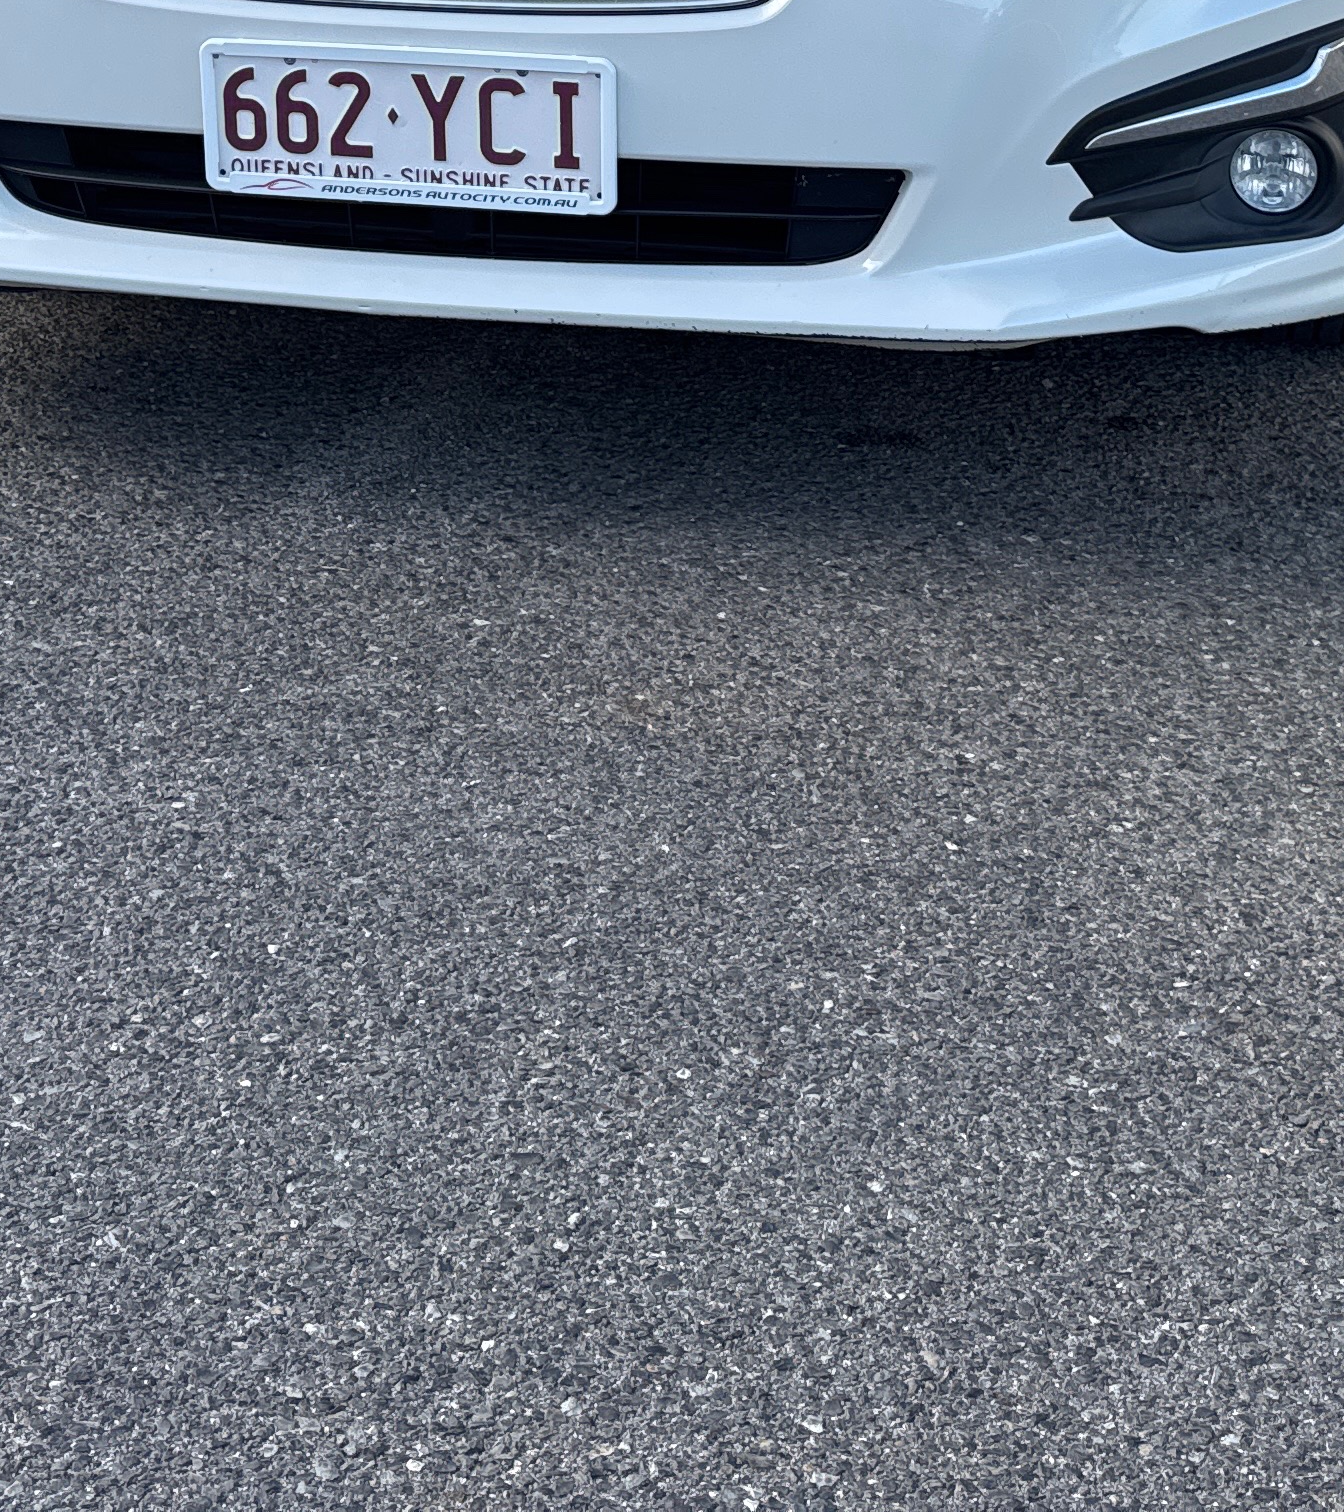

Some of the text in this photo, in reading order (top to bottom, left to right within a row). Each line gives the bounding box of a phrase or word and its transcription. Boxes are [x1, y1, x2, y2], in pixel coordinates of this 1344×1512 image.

[231, 157, 374, 180] QUEENSLAND
[400, 167, 510, 188] SUNSHINE
[524, 175, 590, 193] STATE
